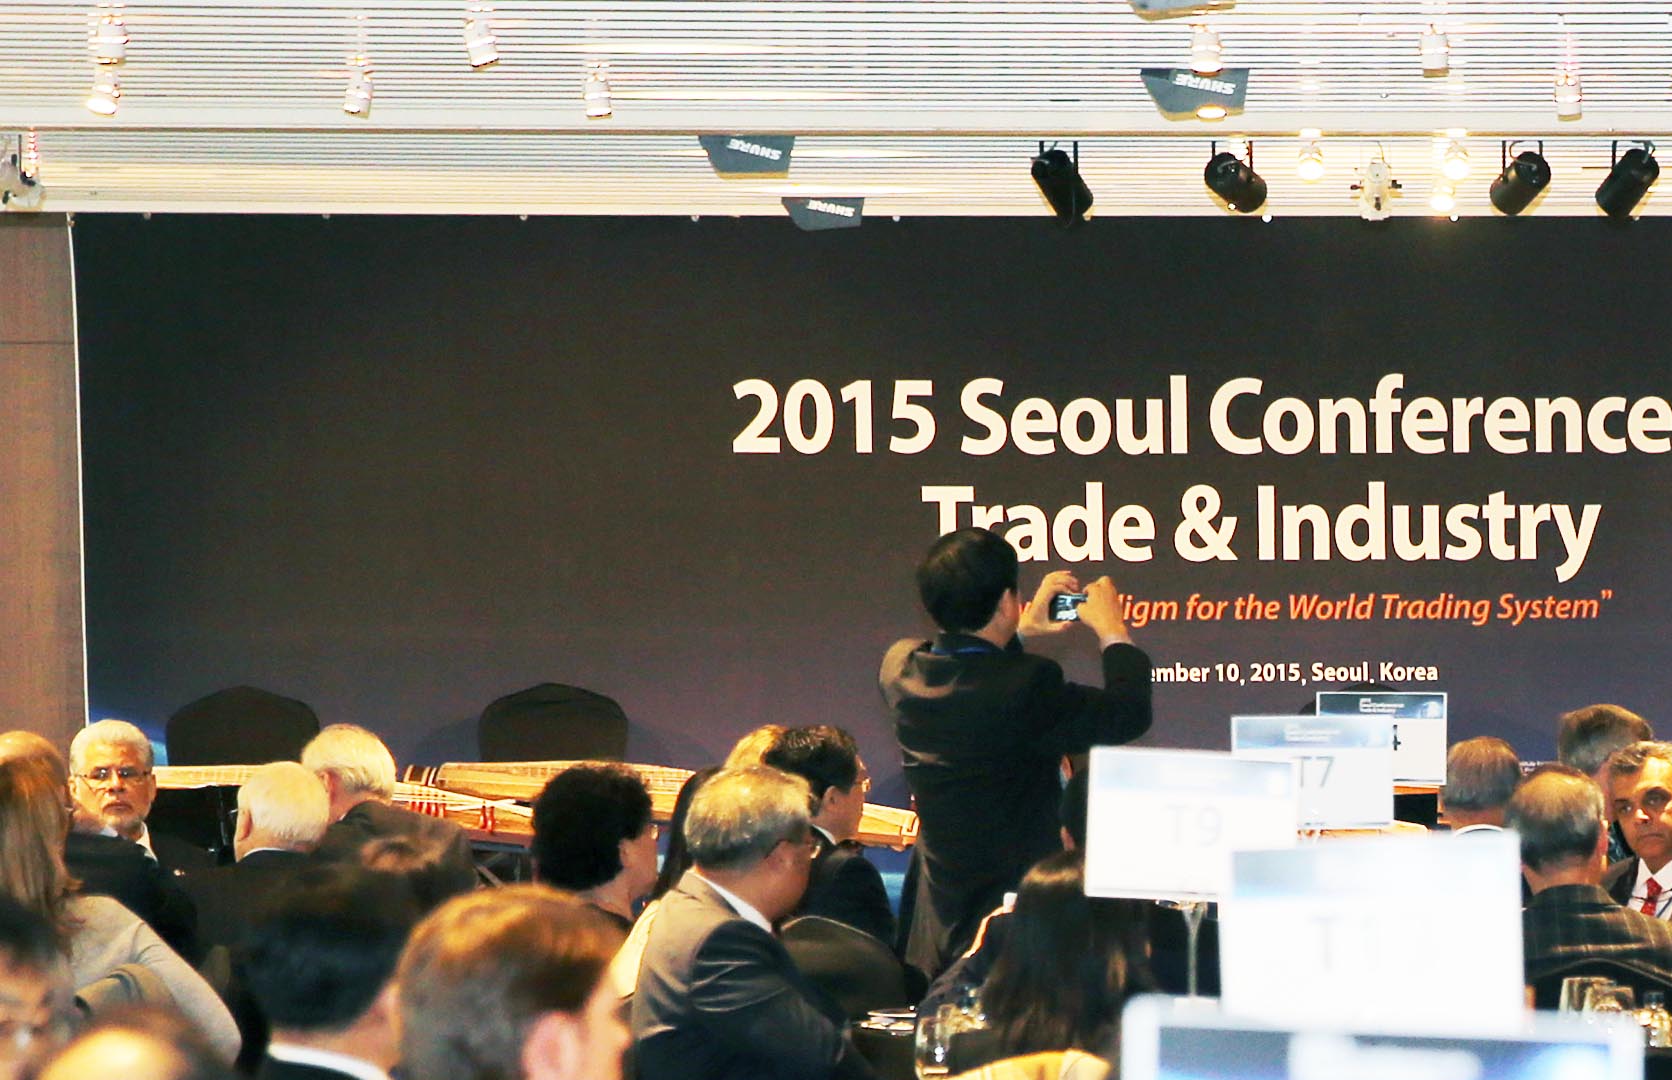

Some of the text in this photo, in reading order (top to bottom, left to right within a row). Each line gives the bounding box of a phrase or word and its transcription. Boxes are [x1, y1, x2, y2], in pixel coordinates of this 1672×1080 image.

[1172, 73, 1236, 95] SHURE
[727, 138, 783, 161] SHURE
[806, 199, 856, 218] SHURE
[733, 379, 936, 455] 2015
[961, 375, 1187, 455] Seoul
[921, 481, 1602, 583] Trade & Industry
[1118, 594, 1178, 628] igm
[1185, 594, 1229, 620] for
[1234, 594, 1286, 620] the
[1289, 594, 1376, 620] World
[1381, 593, 1491, 626] Trading
[1151, 661, 1439, 686] mber 10, 2015, Seoul, Korea
[1293, 755, 1335, 788] T7
[1162, 803, 1226, 848] T9
